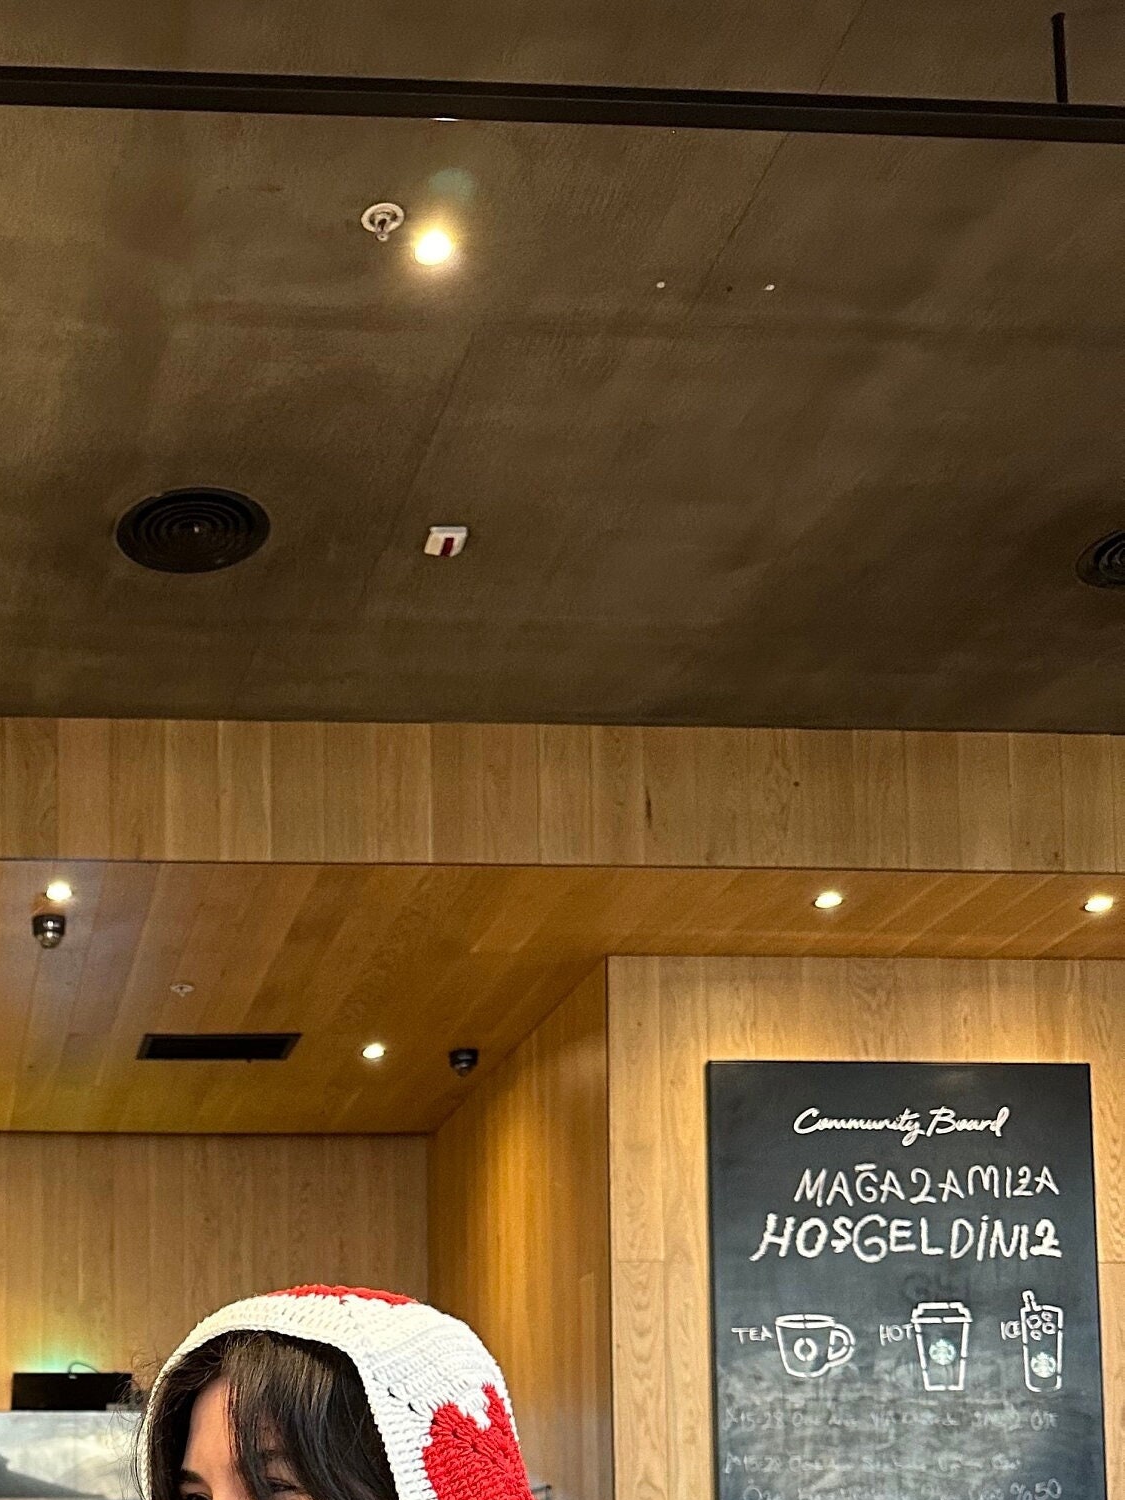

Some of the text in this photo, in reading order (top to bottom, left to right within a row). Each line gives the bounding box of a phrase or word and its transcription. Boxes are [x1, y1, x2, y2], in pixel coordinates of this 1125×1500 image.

[793, 1106, 1010, 1147] Community Board
[731, 1324, 773, 1345] TEA
[879, 1323, 914, 1346] HOT
